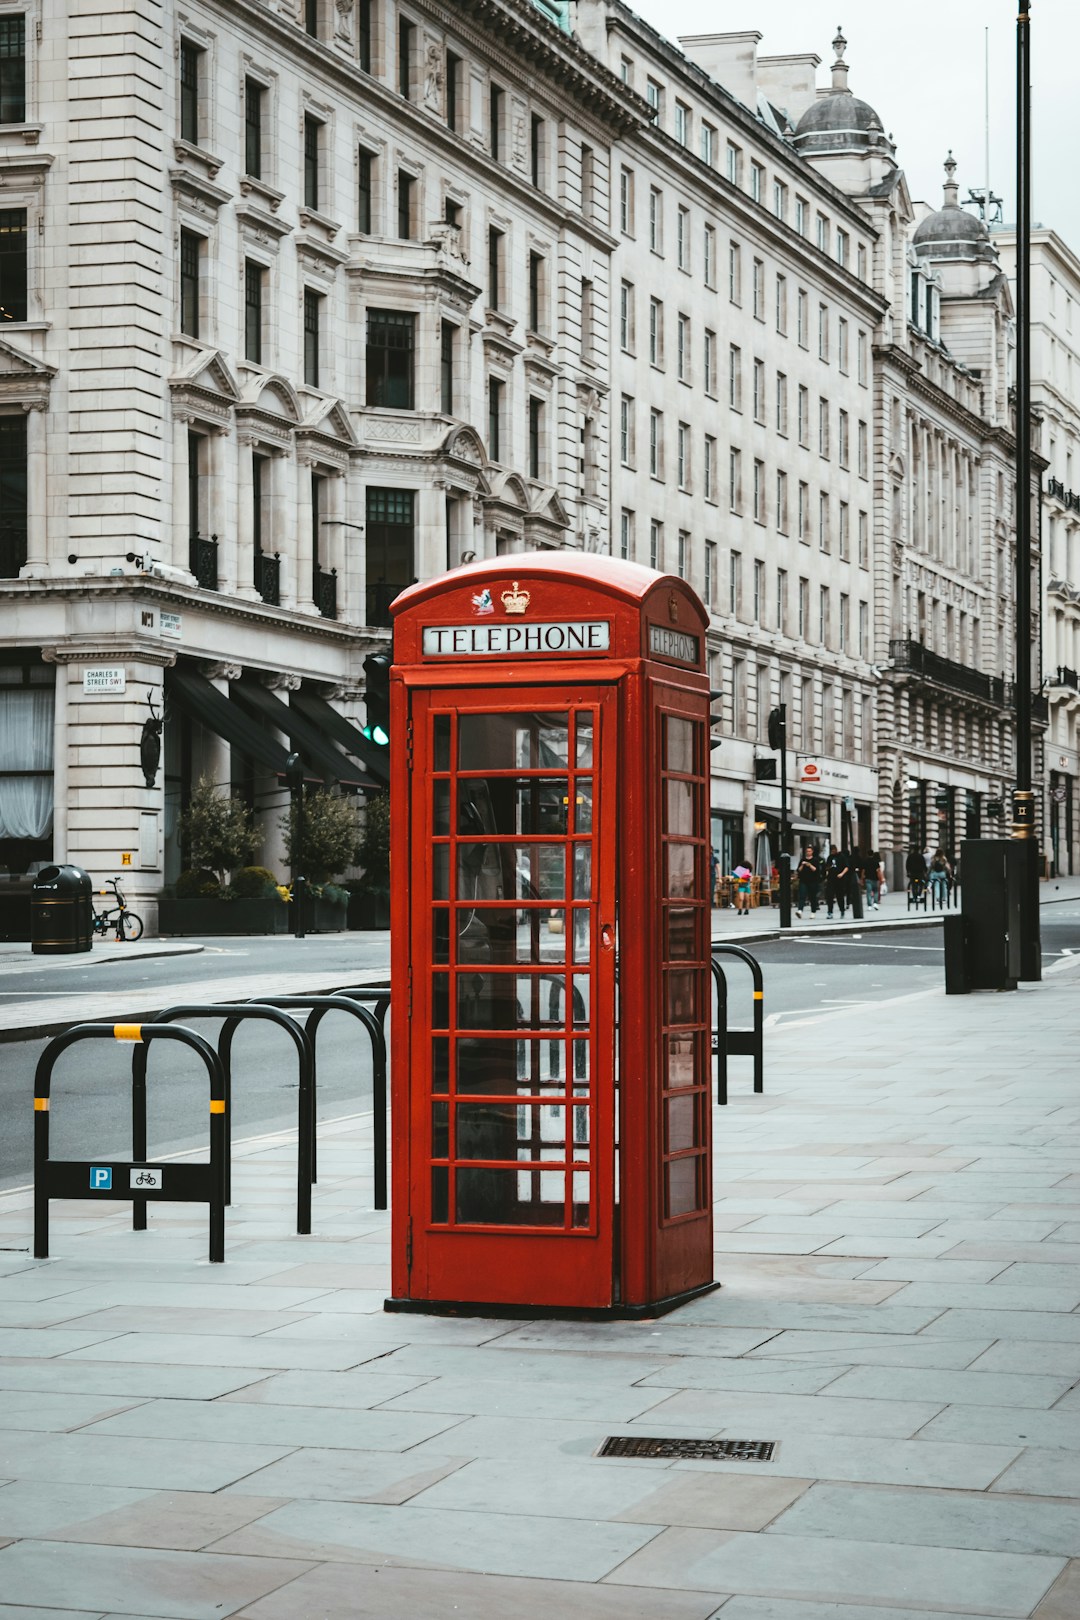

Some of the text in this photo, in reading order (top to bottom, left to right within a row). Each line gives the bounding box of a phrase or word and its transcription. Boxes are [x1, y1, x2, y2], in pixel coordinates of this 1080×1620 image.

[430, 624, 602, 653] TELEPHONE
[87, 678, 108, 686] STREET
[95, 1169, 109, 1187] P
